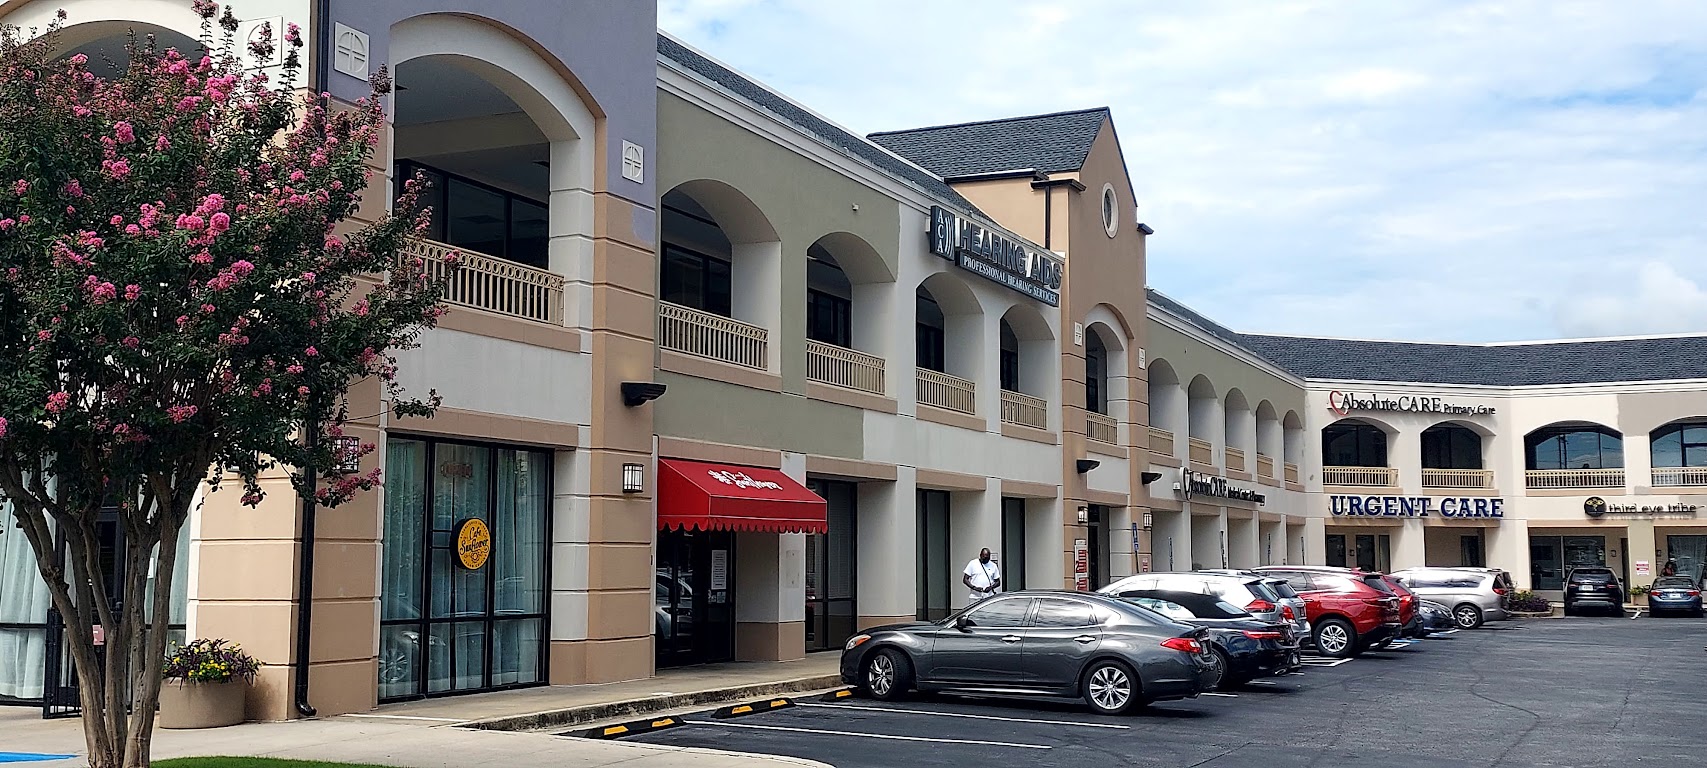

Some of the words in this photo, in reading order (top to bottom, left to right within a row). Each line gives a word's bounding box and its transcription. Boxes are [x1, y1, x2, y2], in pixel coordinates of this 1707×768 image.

[960, 217, 1027, 274] HEARING
[1030, 252, 1063, 290] AIDS
[963, 255, 1007, 283] PROFESSIONAL
[1007, 275, 1033, 294] HEARING
[1033, 285, 1057, 304] SERVICES
[1443, 403, 1475, 417] Primary
[1477, 404, 1497, 415] Care
[1330, 496, 1432, 517] URGENT
[1440, 498, 1504, 518] CARE
[1609, 503, 1637, 513] third
[1641, 507, 1663, 516] eye
[1667, 502, 1697, 513] tribe
